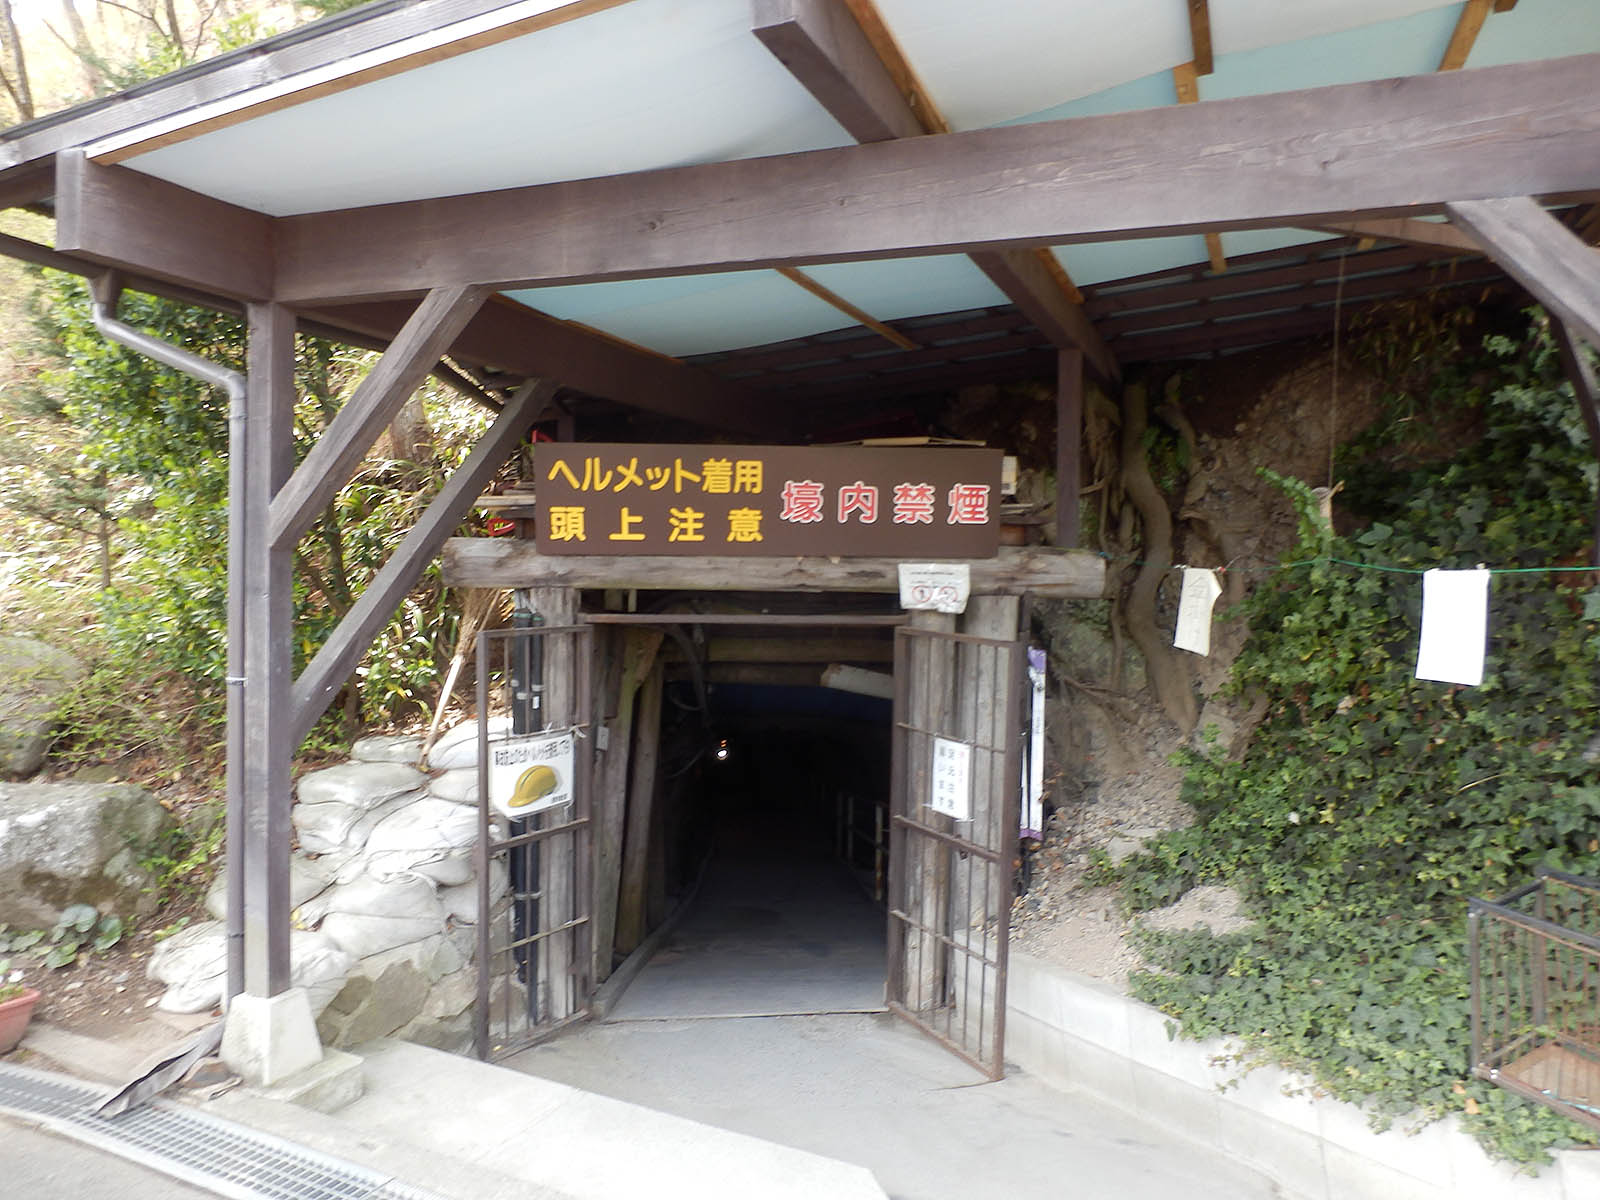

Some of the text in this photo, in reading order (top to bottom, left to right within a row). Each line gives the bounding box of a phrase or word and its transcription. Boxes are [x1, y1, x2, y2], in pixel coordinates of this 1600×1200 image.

[548, 457, 763, 494] ヘルメット着用
[780, 480, 990, 525] 壕内禁煙
[549, 506, 763, 542] 頭上注意
